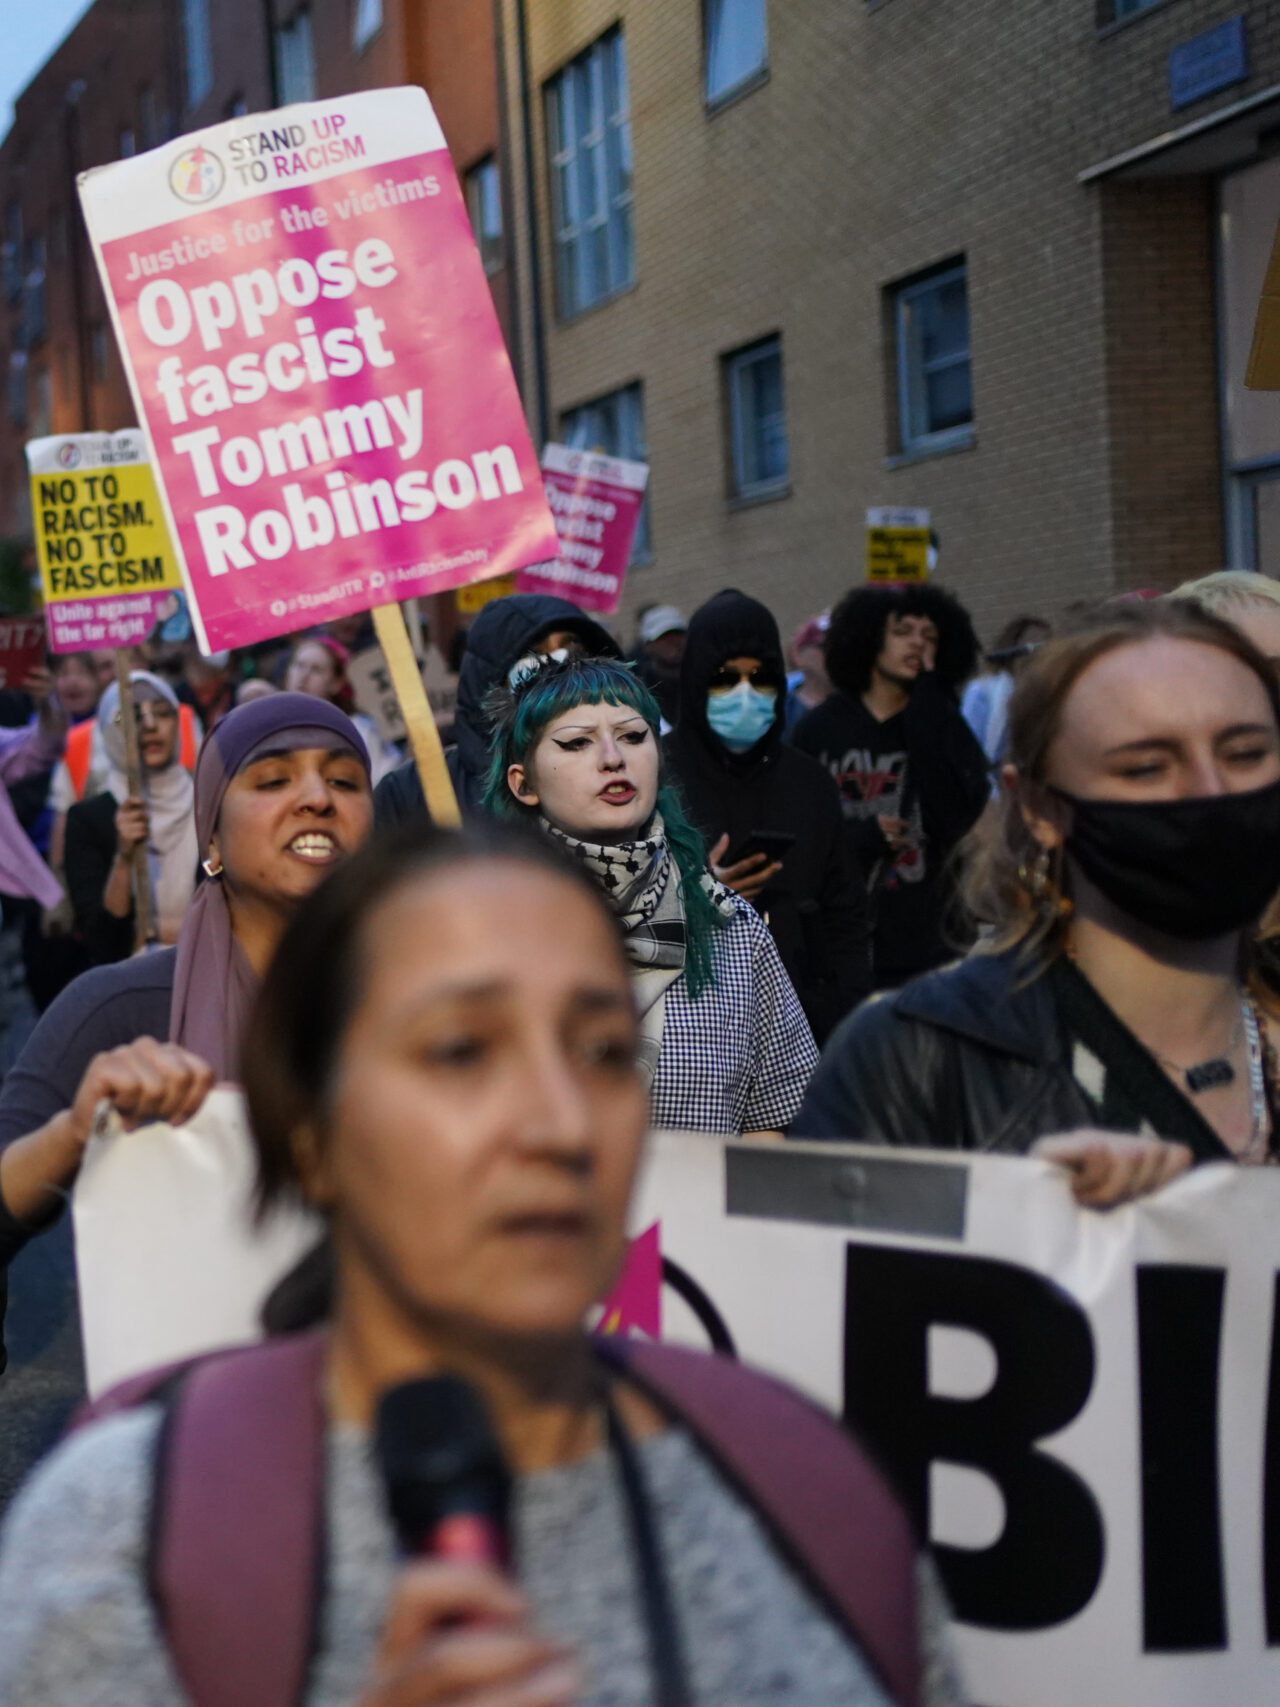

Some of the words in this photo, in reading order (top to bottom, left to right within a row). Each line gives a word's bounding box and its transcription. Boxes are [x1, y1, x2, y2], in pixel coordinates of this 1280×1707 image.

[228, 125, 306, 161] STAND
[312, 114, 347, 140] UP
[234, 158, 268, 187] TO
[274, 135, 367, 179] RACISM
[126, 230, 227, 282] Justice
[232, 216, 275, 249] for
[280, 204, 330, 235] the
[333, 173, 442, 222] victims
[136, 238, 398, 352] Oppose
[156, 306, 396, 425] fascist
[171, 388, 423, 499] Tommy
[40, 478, 77, 506] NO
[84, 474, 118, 502] TO
[193, 444, 524, 578] Robinson
[45, 536, 83, 564] NO
[92, 532, 127, 560] TO
[49, 556, 166, 594] FASCISM
[52, 604, 94, 624] Unite
[97, 596, 152, 621] against
[54, 625, 82, 644] the
[82, 622, 107, 640] far
[108, 617, 146, 642] right
[842, 1241, 1280, 1658] BI
